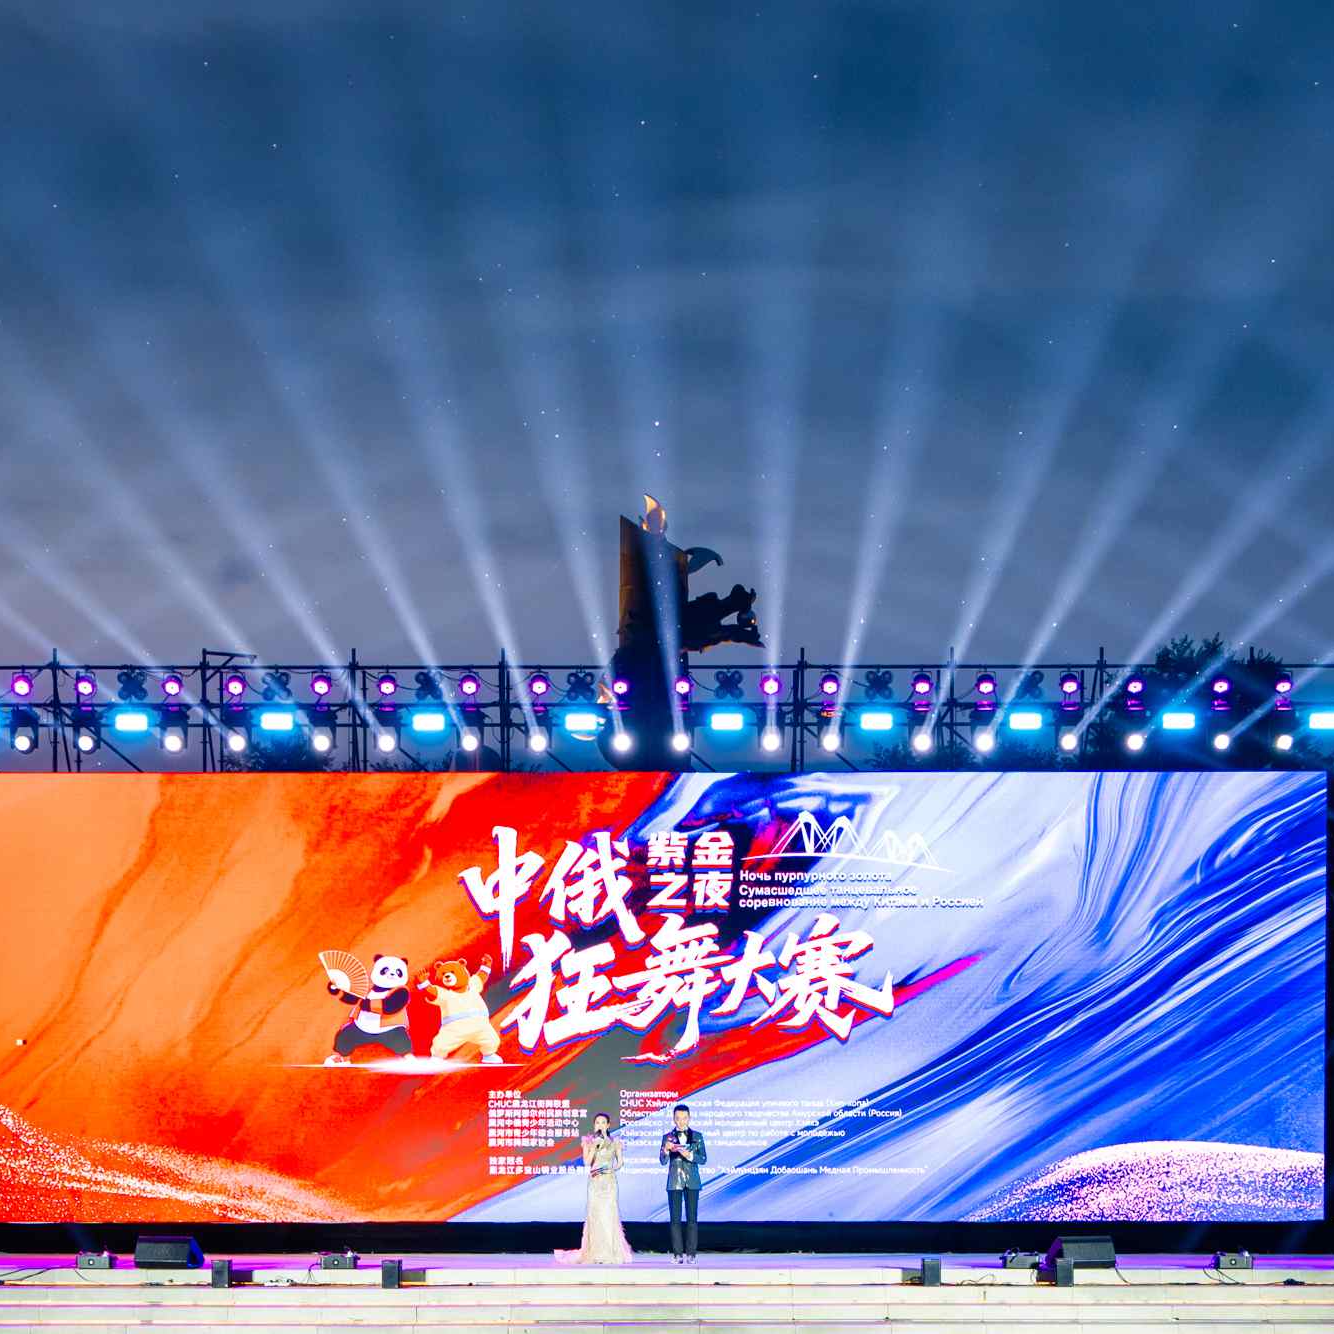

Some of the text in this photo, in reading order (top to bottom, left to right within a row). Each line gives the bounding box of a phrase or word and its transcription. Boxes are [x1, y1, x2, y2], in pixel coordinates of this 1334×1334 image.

[646, 831, 734, 867] 紫金
[646, 871, 733, 907] 之夜
[739, 885, 827, 897] Сумасшедшее
[740, 870, 772, 881] Ночь
[775, 872, 847, 884] пурпурного
[458, 826, 646, 970] 中俄
[500, 912, 895, 1062] 狂舞大赛
